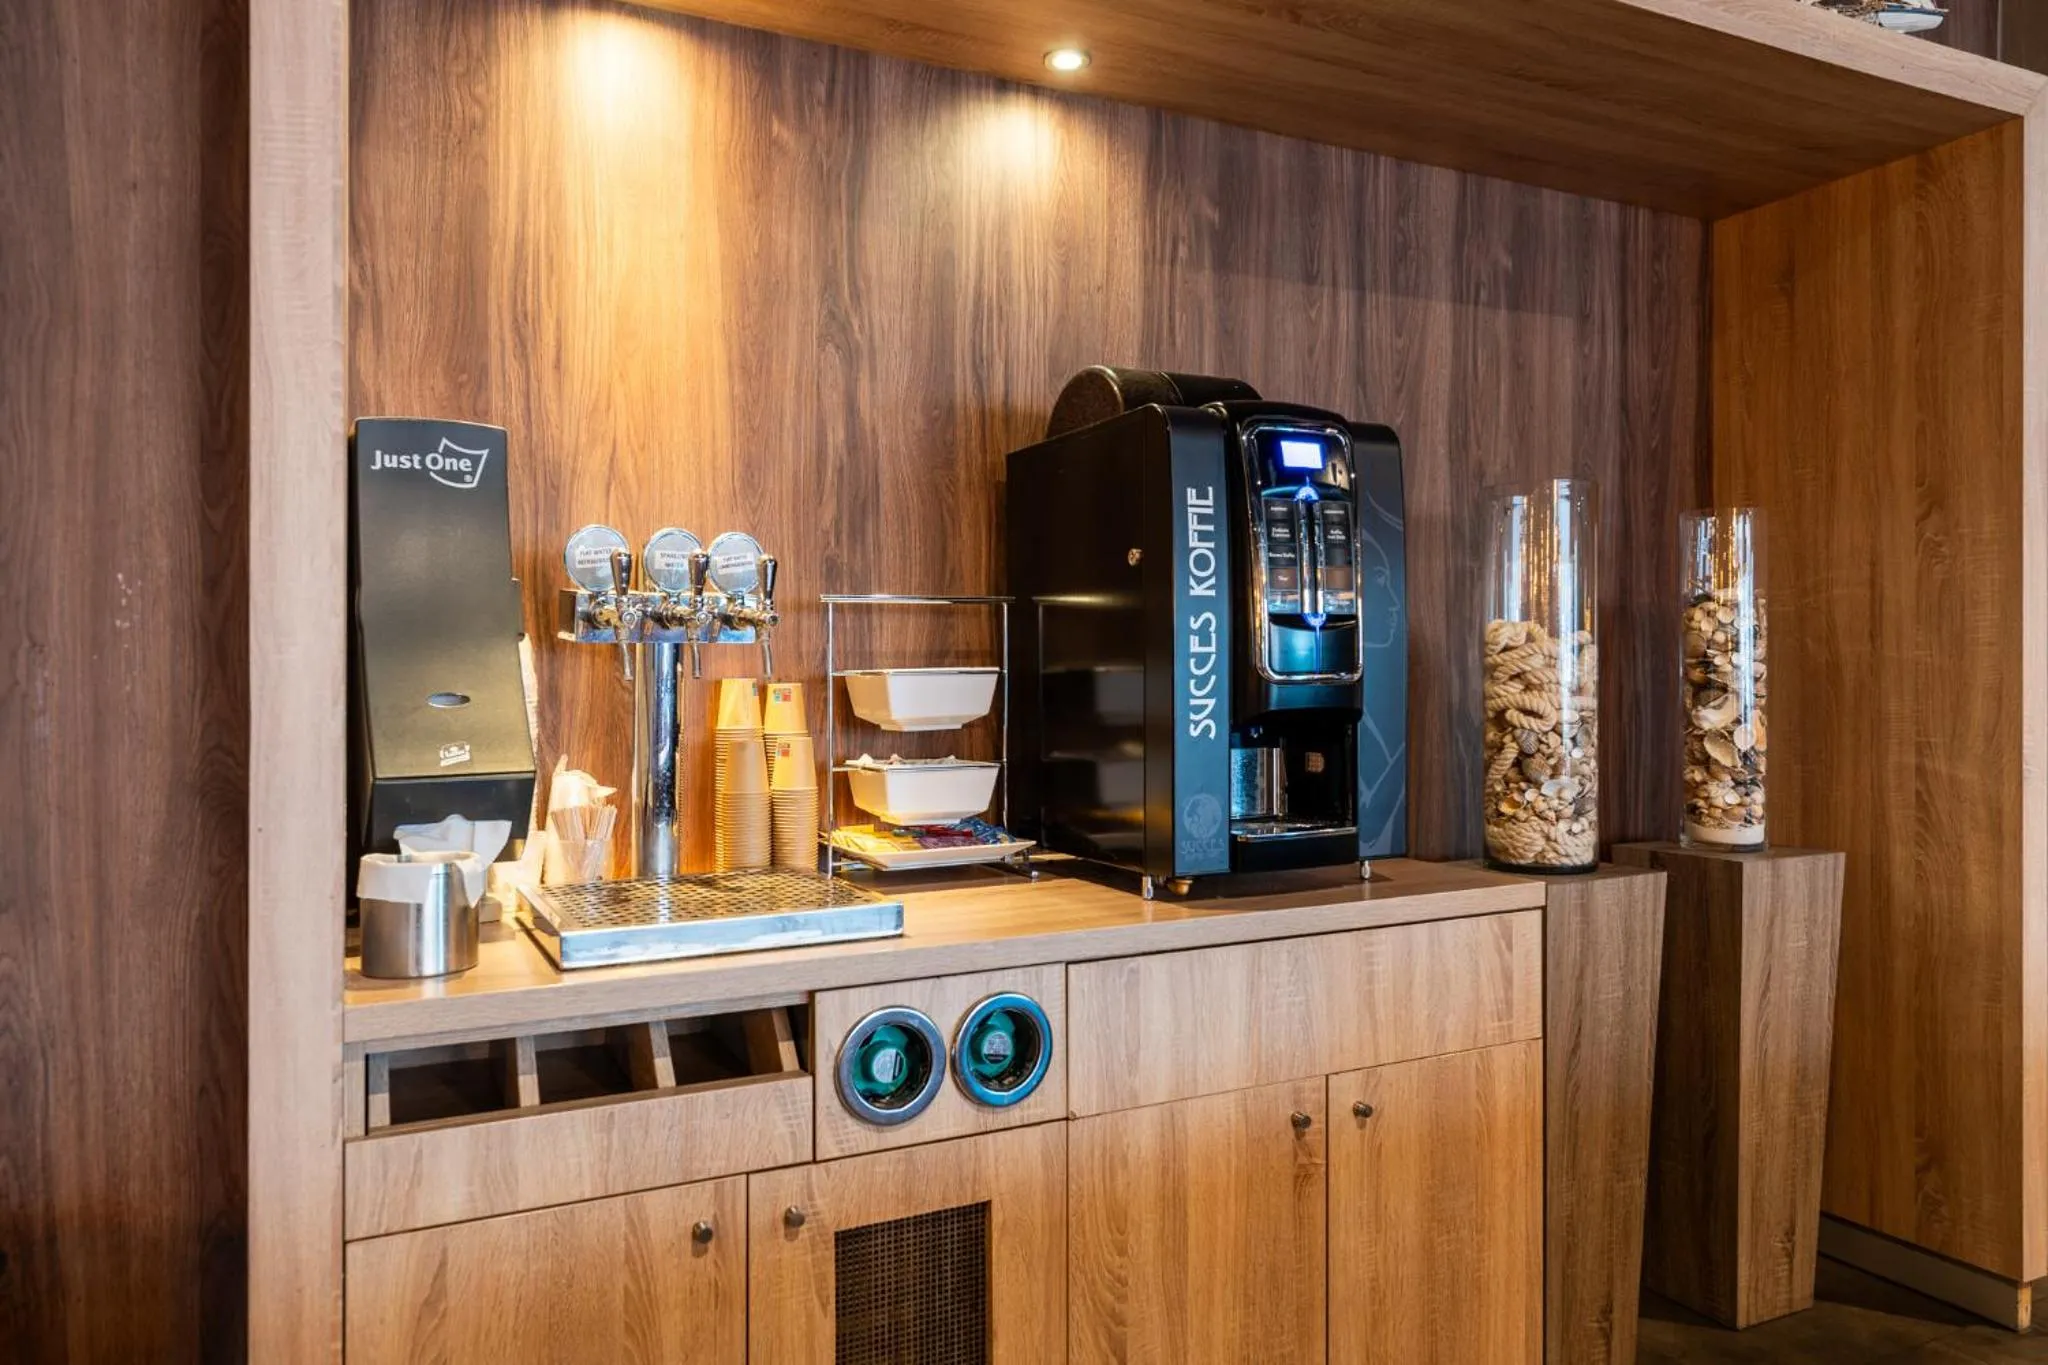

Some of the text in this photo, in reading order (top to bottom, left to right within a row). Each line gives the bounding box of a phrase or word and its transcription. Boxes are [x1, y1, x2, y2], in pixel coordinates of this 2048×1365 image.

[370, 449, 472, 472] Just One
[1187, 486, 1217, 740] SUCCES KOFFIE
